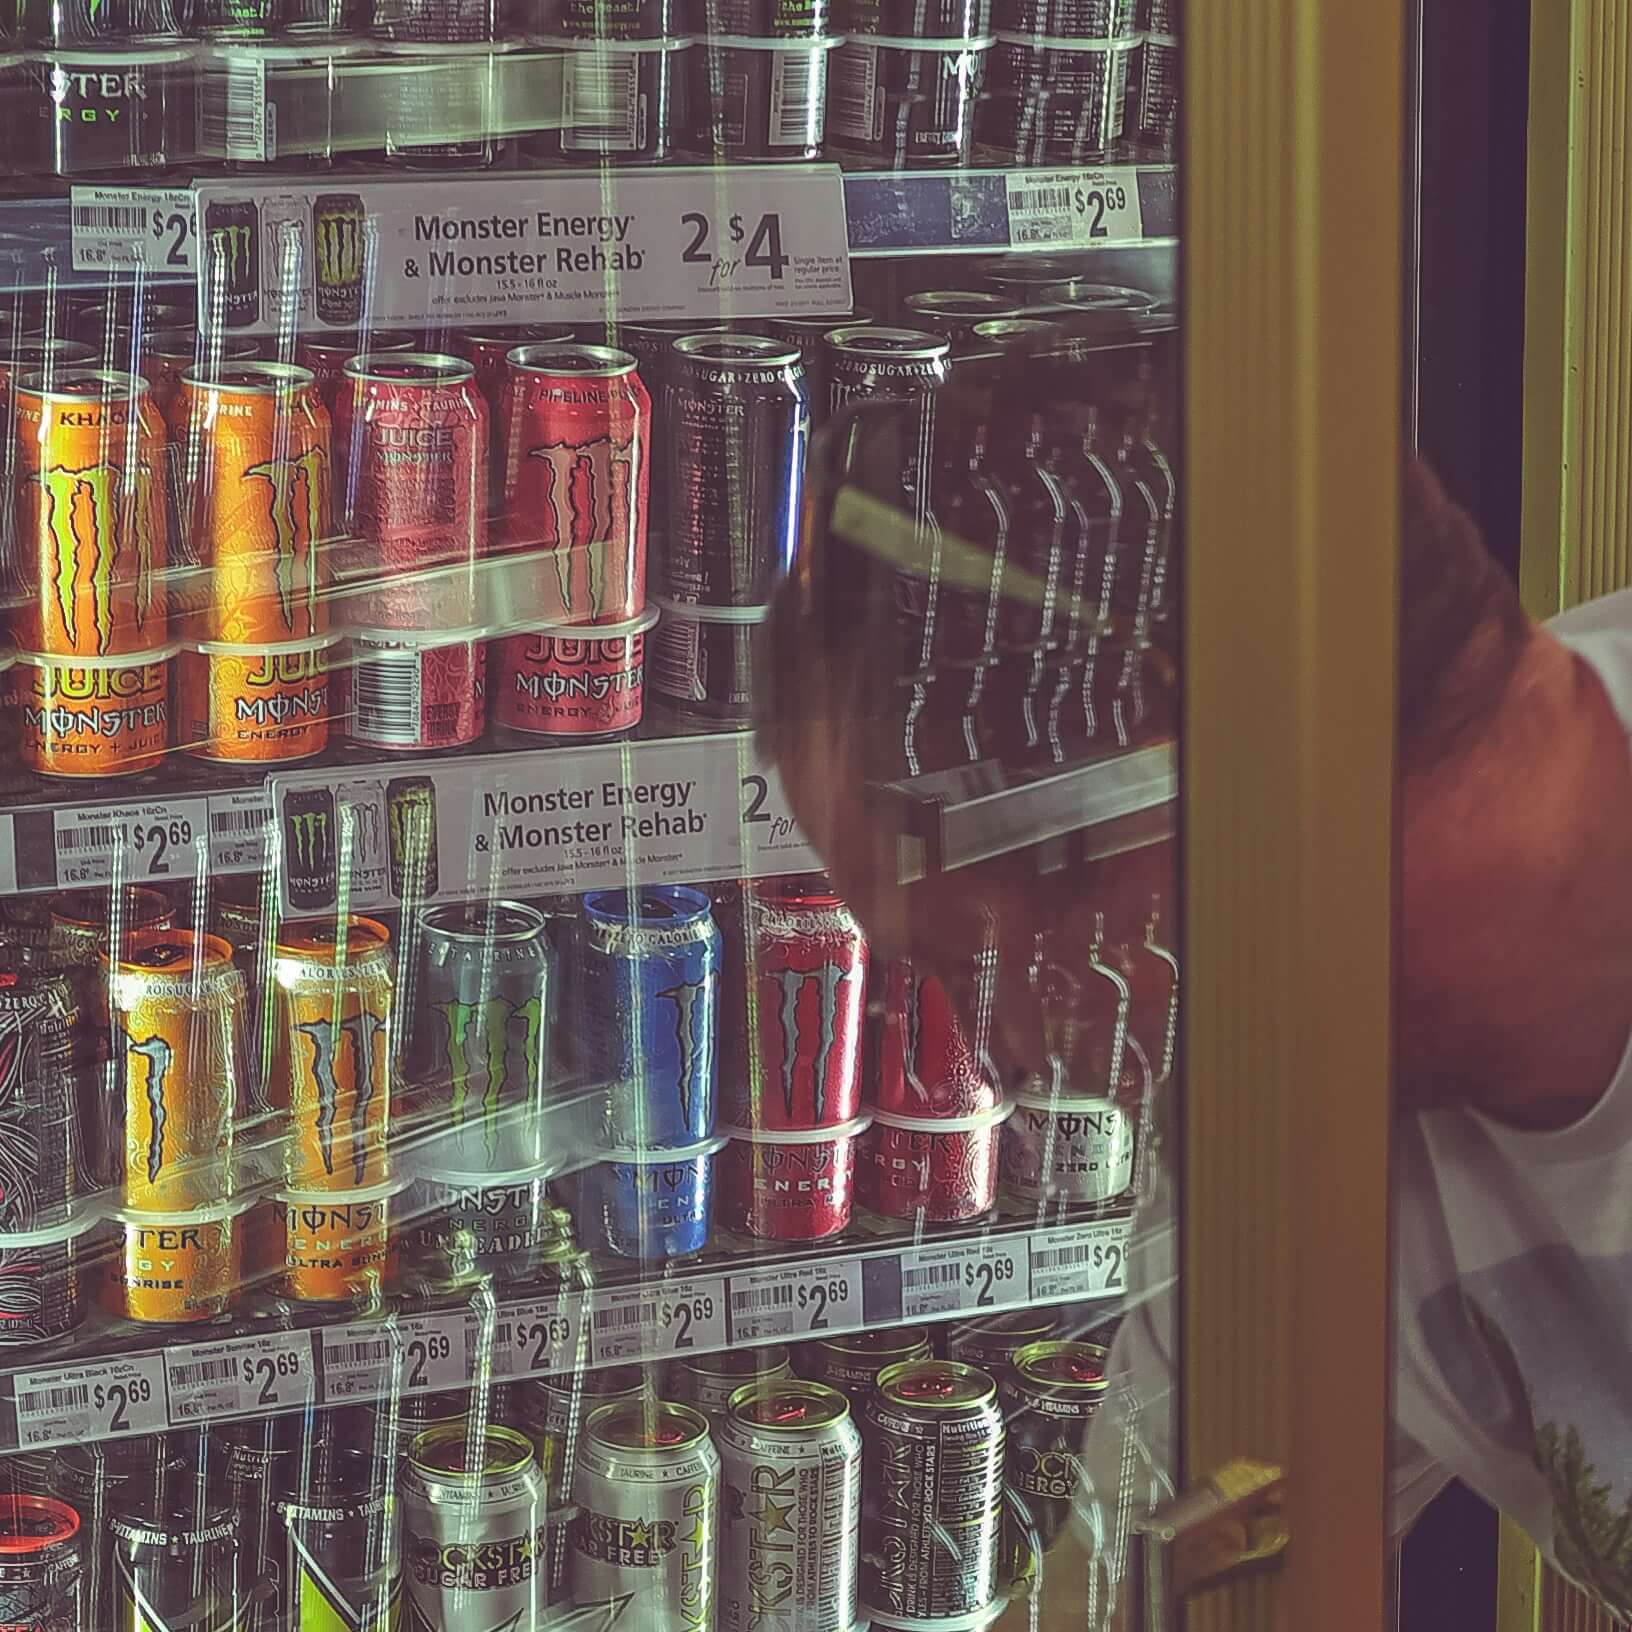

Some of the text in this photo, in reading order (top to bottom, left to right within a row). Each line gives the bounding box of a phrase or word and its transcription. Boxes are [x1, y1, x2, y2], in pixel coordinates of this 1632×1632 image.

[415, 213, 635, 241] Monster Energy
[404, 248, 646, 278] & Monster Rehab
[681, 212, 789, 286] 2 for $4
[483, 779, 696, 817] Monster Energy
[741, 776, 771, 823] 2
[475, 809, 707, 853] & Monster Rehab
